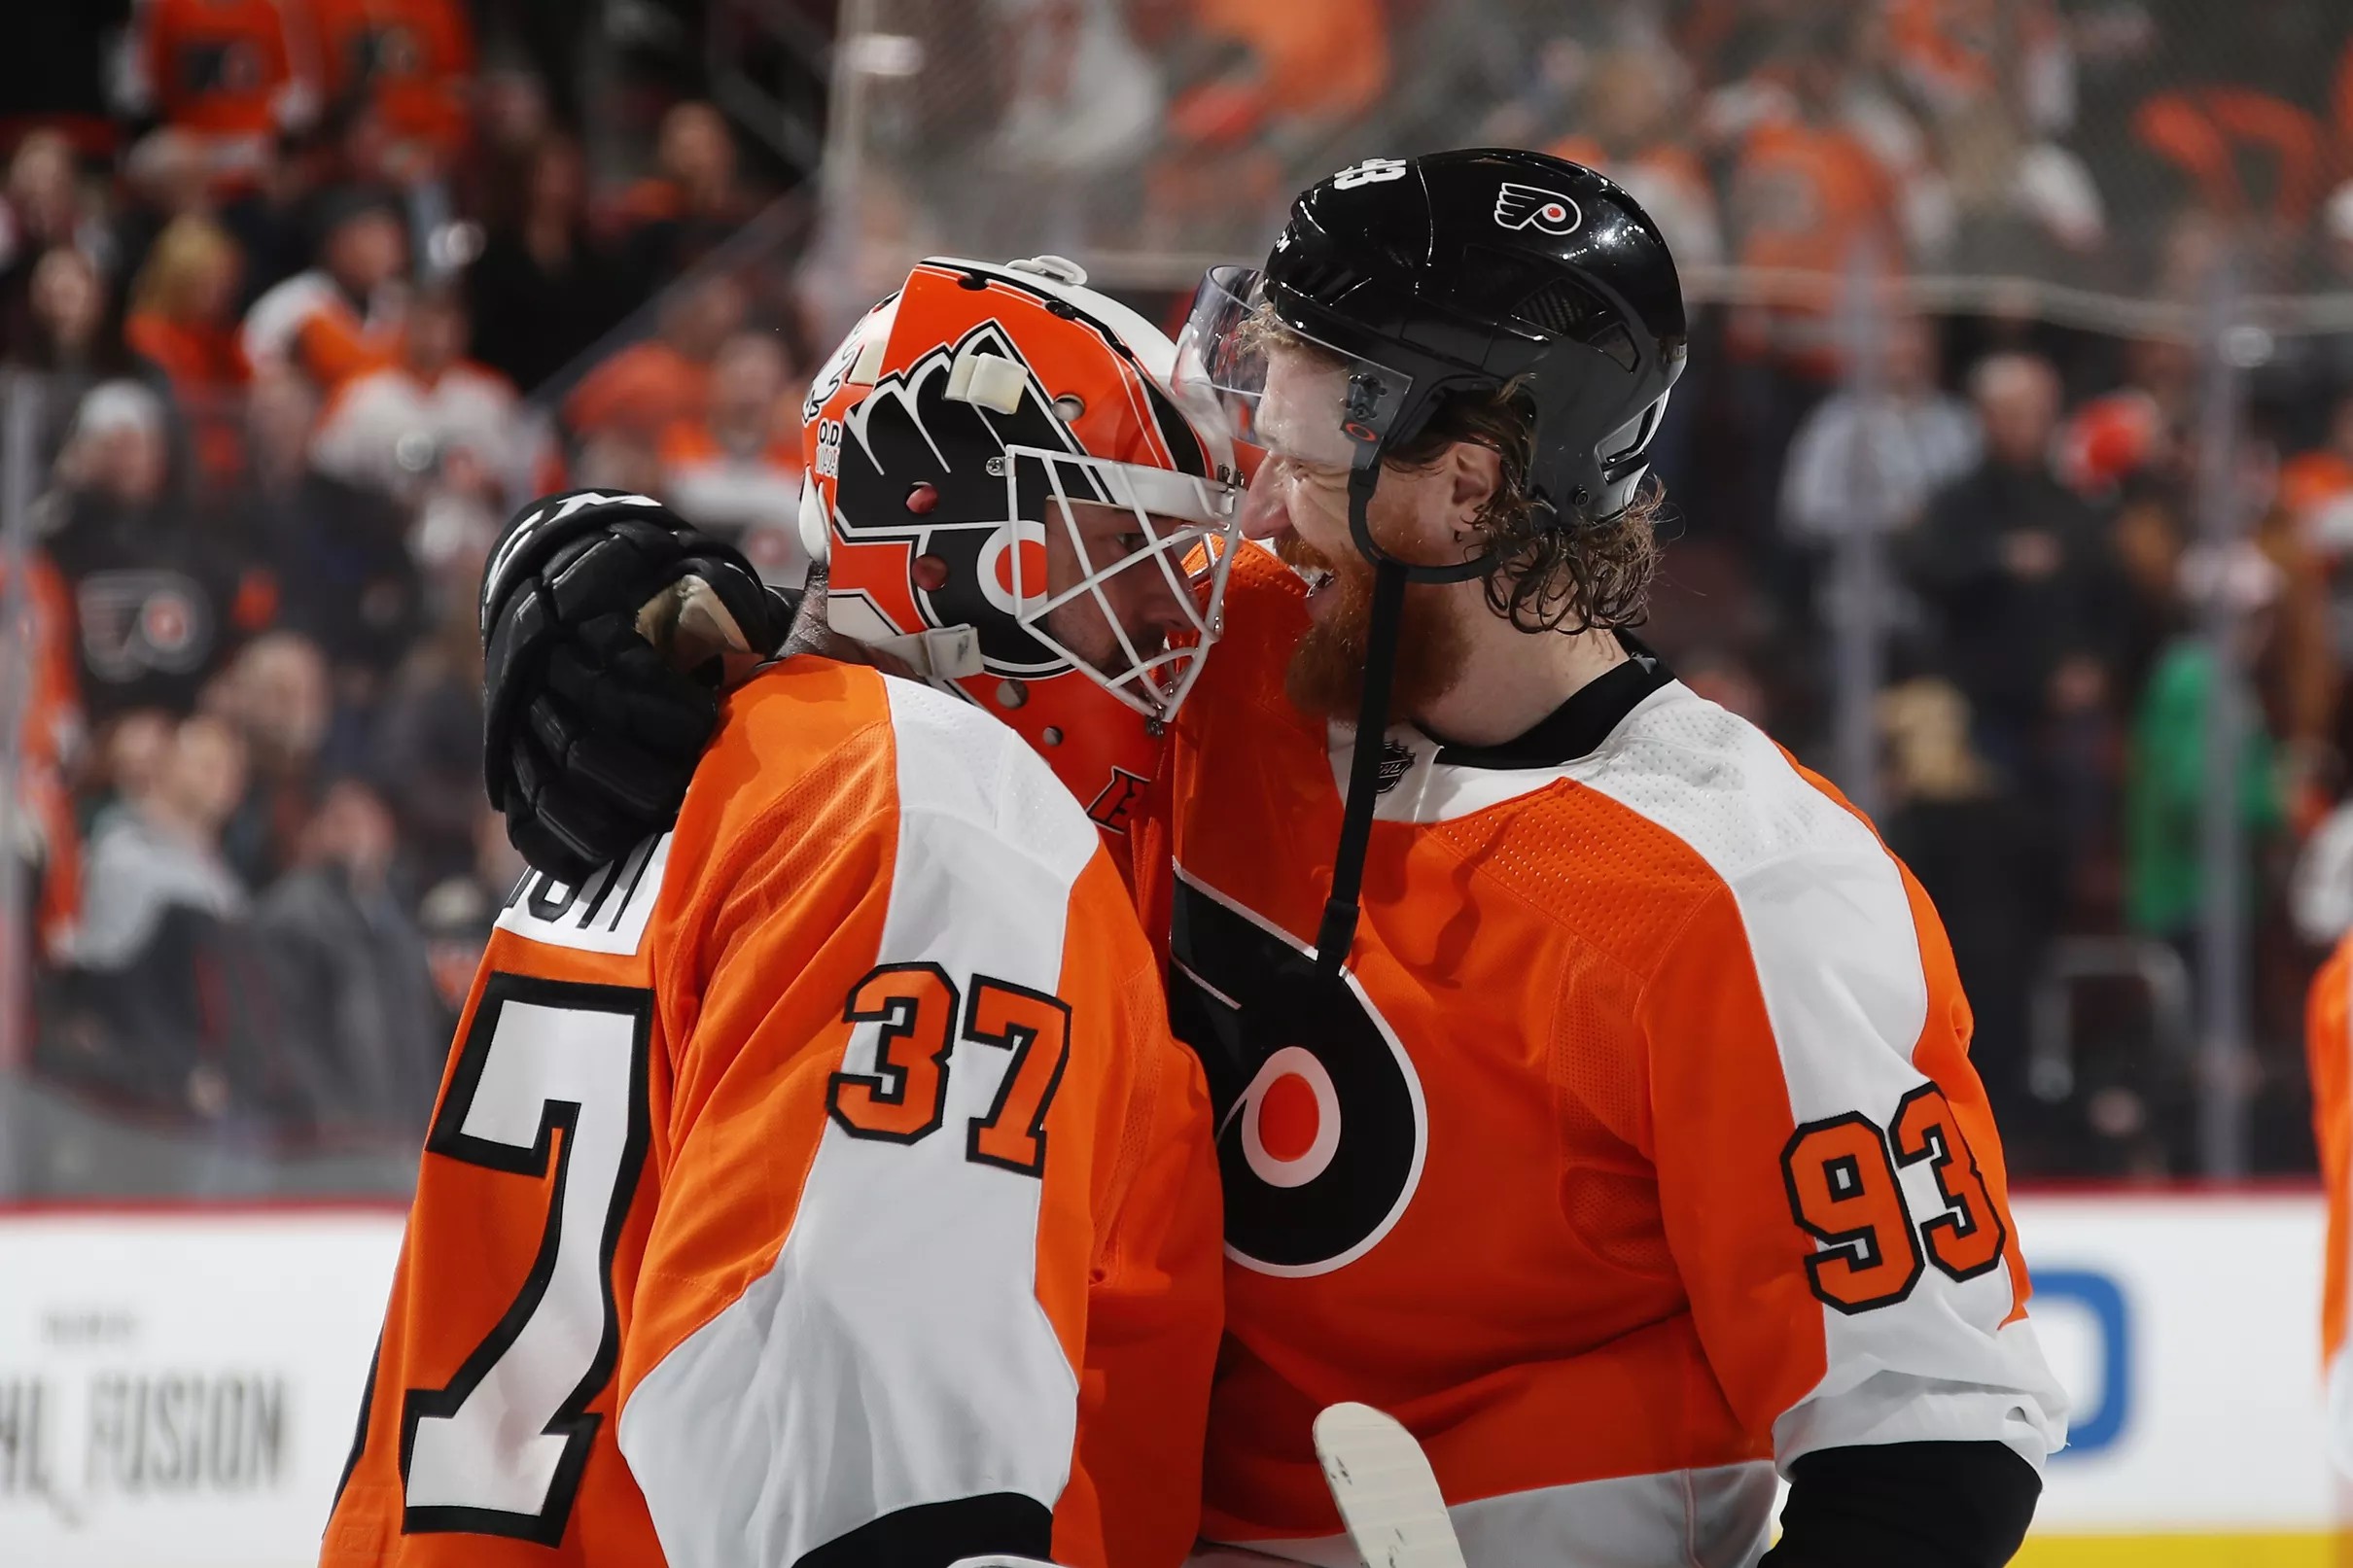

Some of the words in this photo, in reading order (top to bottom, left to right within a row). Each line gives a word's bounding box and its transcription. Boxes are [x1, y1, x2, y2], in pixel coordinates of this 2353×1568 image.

[825, 961, 1072, 1179] 37
[389, 971, 654, 1549] 7
[1779, 1080, 2006, 1316] 93
[88, 1369, 290, 1500] FUSION
